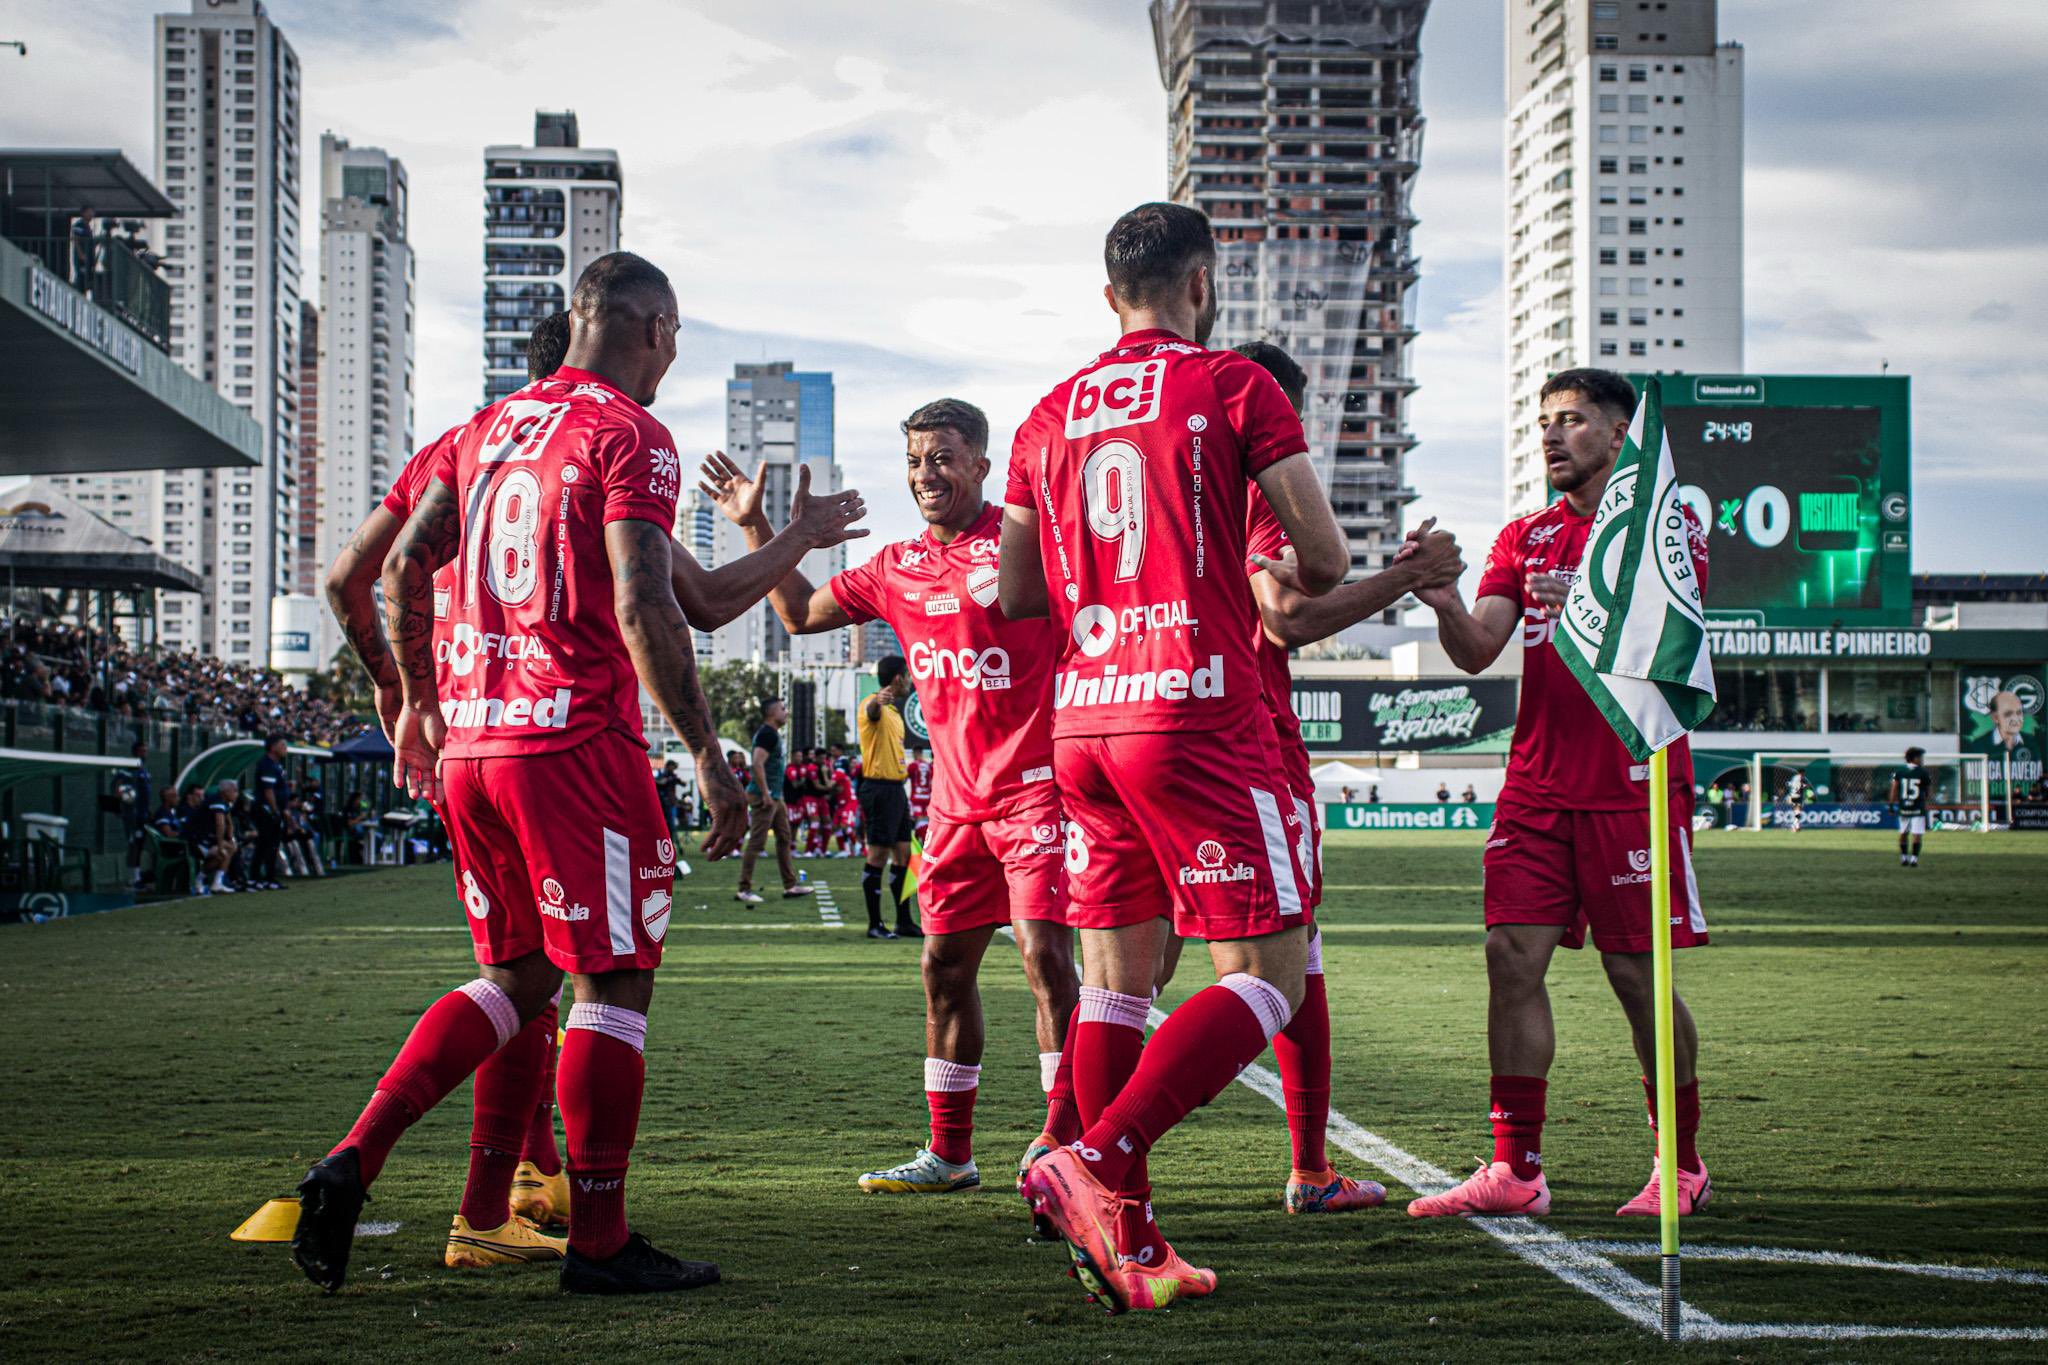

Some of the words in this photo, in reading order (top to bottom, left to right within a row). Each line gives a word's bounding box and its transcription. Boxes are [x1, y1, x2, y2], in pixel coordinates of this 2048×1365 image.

[1072, 363, 1158, 421] bcj
[487, 403, 564, 456] bcj
[1702, 421, 1753, 443] 24:49
[1193, 437, 1201, 471] CASA
[1193, 474, 1201, 492] DO
[559, 487, 570, 520] CASA
[1080, 438, 1147, 584] 9
[1743, 485, 1791, 548] 0
[465, 467, 544, 609] 18
[558, 523, 566, 541] DO
[1193, 495, 1204, 577] MARCENEIRO
[550, 544, 565, 622] MARCENEIRO
[927, 602, 958, 613] LUZTOL
[1120, 600, 1198, 633] OFICIAL
[1835, 631, 1932, 656] PINHEIRO
[909, 638, 1010, 690] Ginga
[1054, 655, 1225, 710] Unimed
[441, 688, 571, 729] nimed
[1965, 761, 2001, 780] NUCA
[1901, 778, 1921, 800] 15
[1344, 806, 1446, 828] Unimed
[577, 1177, 621, 1194] VOLT
